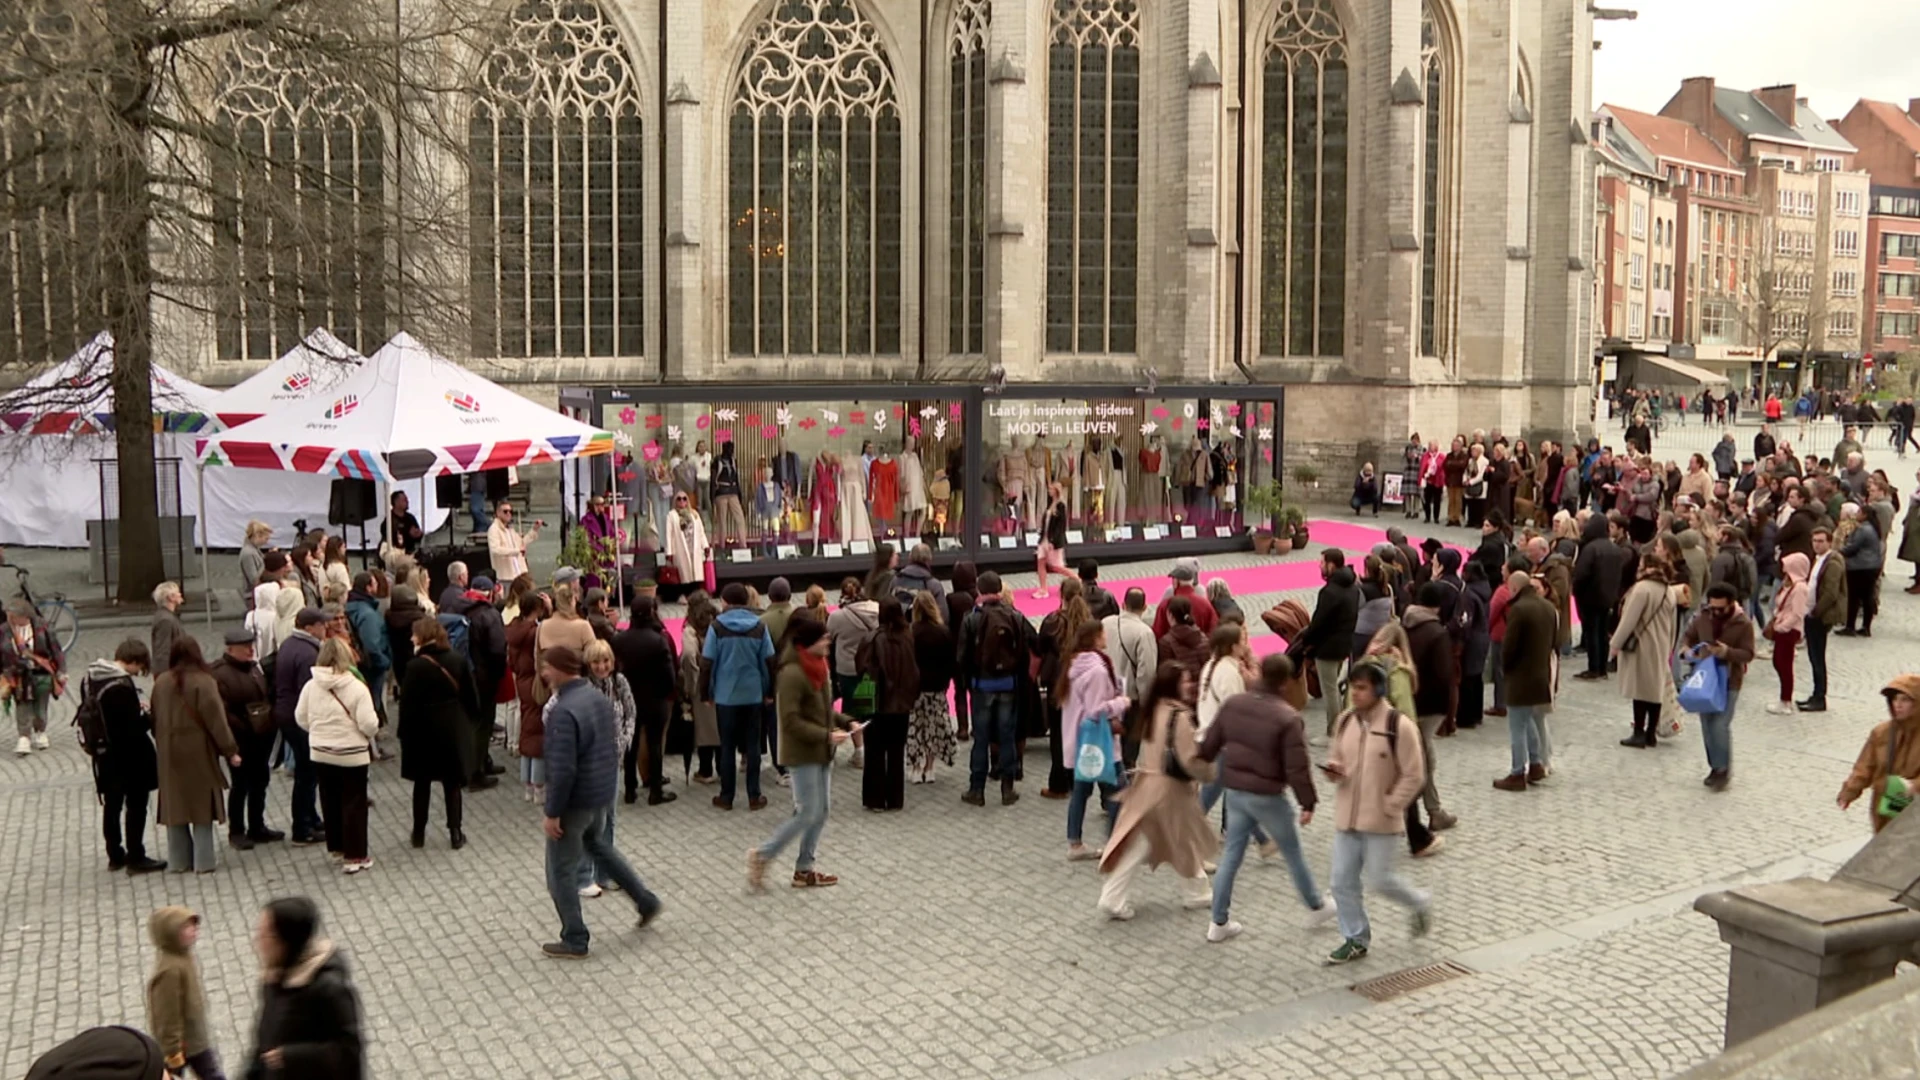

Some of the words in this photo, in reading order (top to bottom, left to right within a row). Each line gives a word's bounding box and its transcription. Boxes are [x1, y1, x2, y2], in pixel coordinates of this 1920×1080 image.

[989, 403, 1016, 417] Laat
[1018, 404, 1030, 420] je
[1033, 403, 1092, 420] inspireren
[1095, 403, 1135, 418] tijdens
[1007, 422, 1049, 435] MODE
[1052, 421, 1063, 434] in
[1066, 420, 1117, 434] LEUVEN
